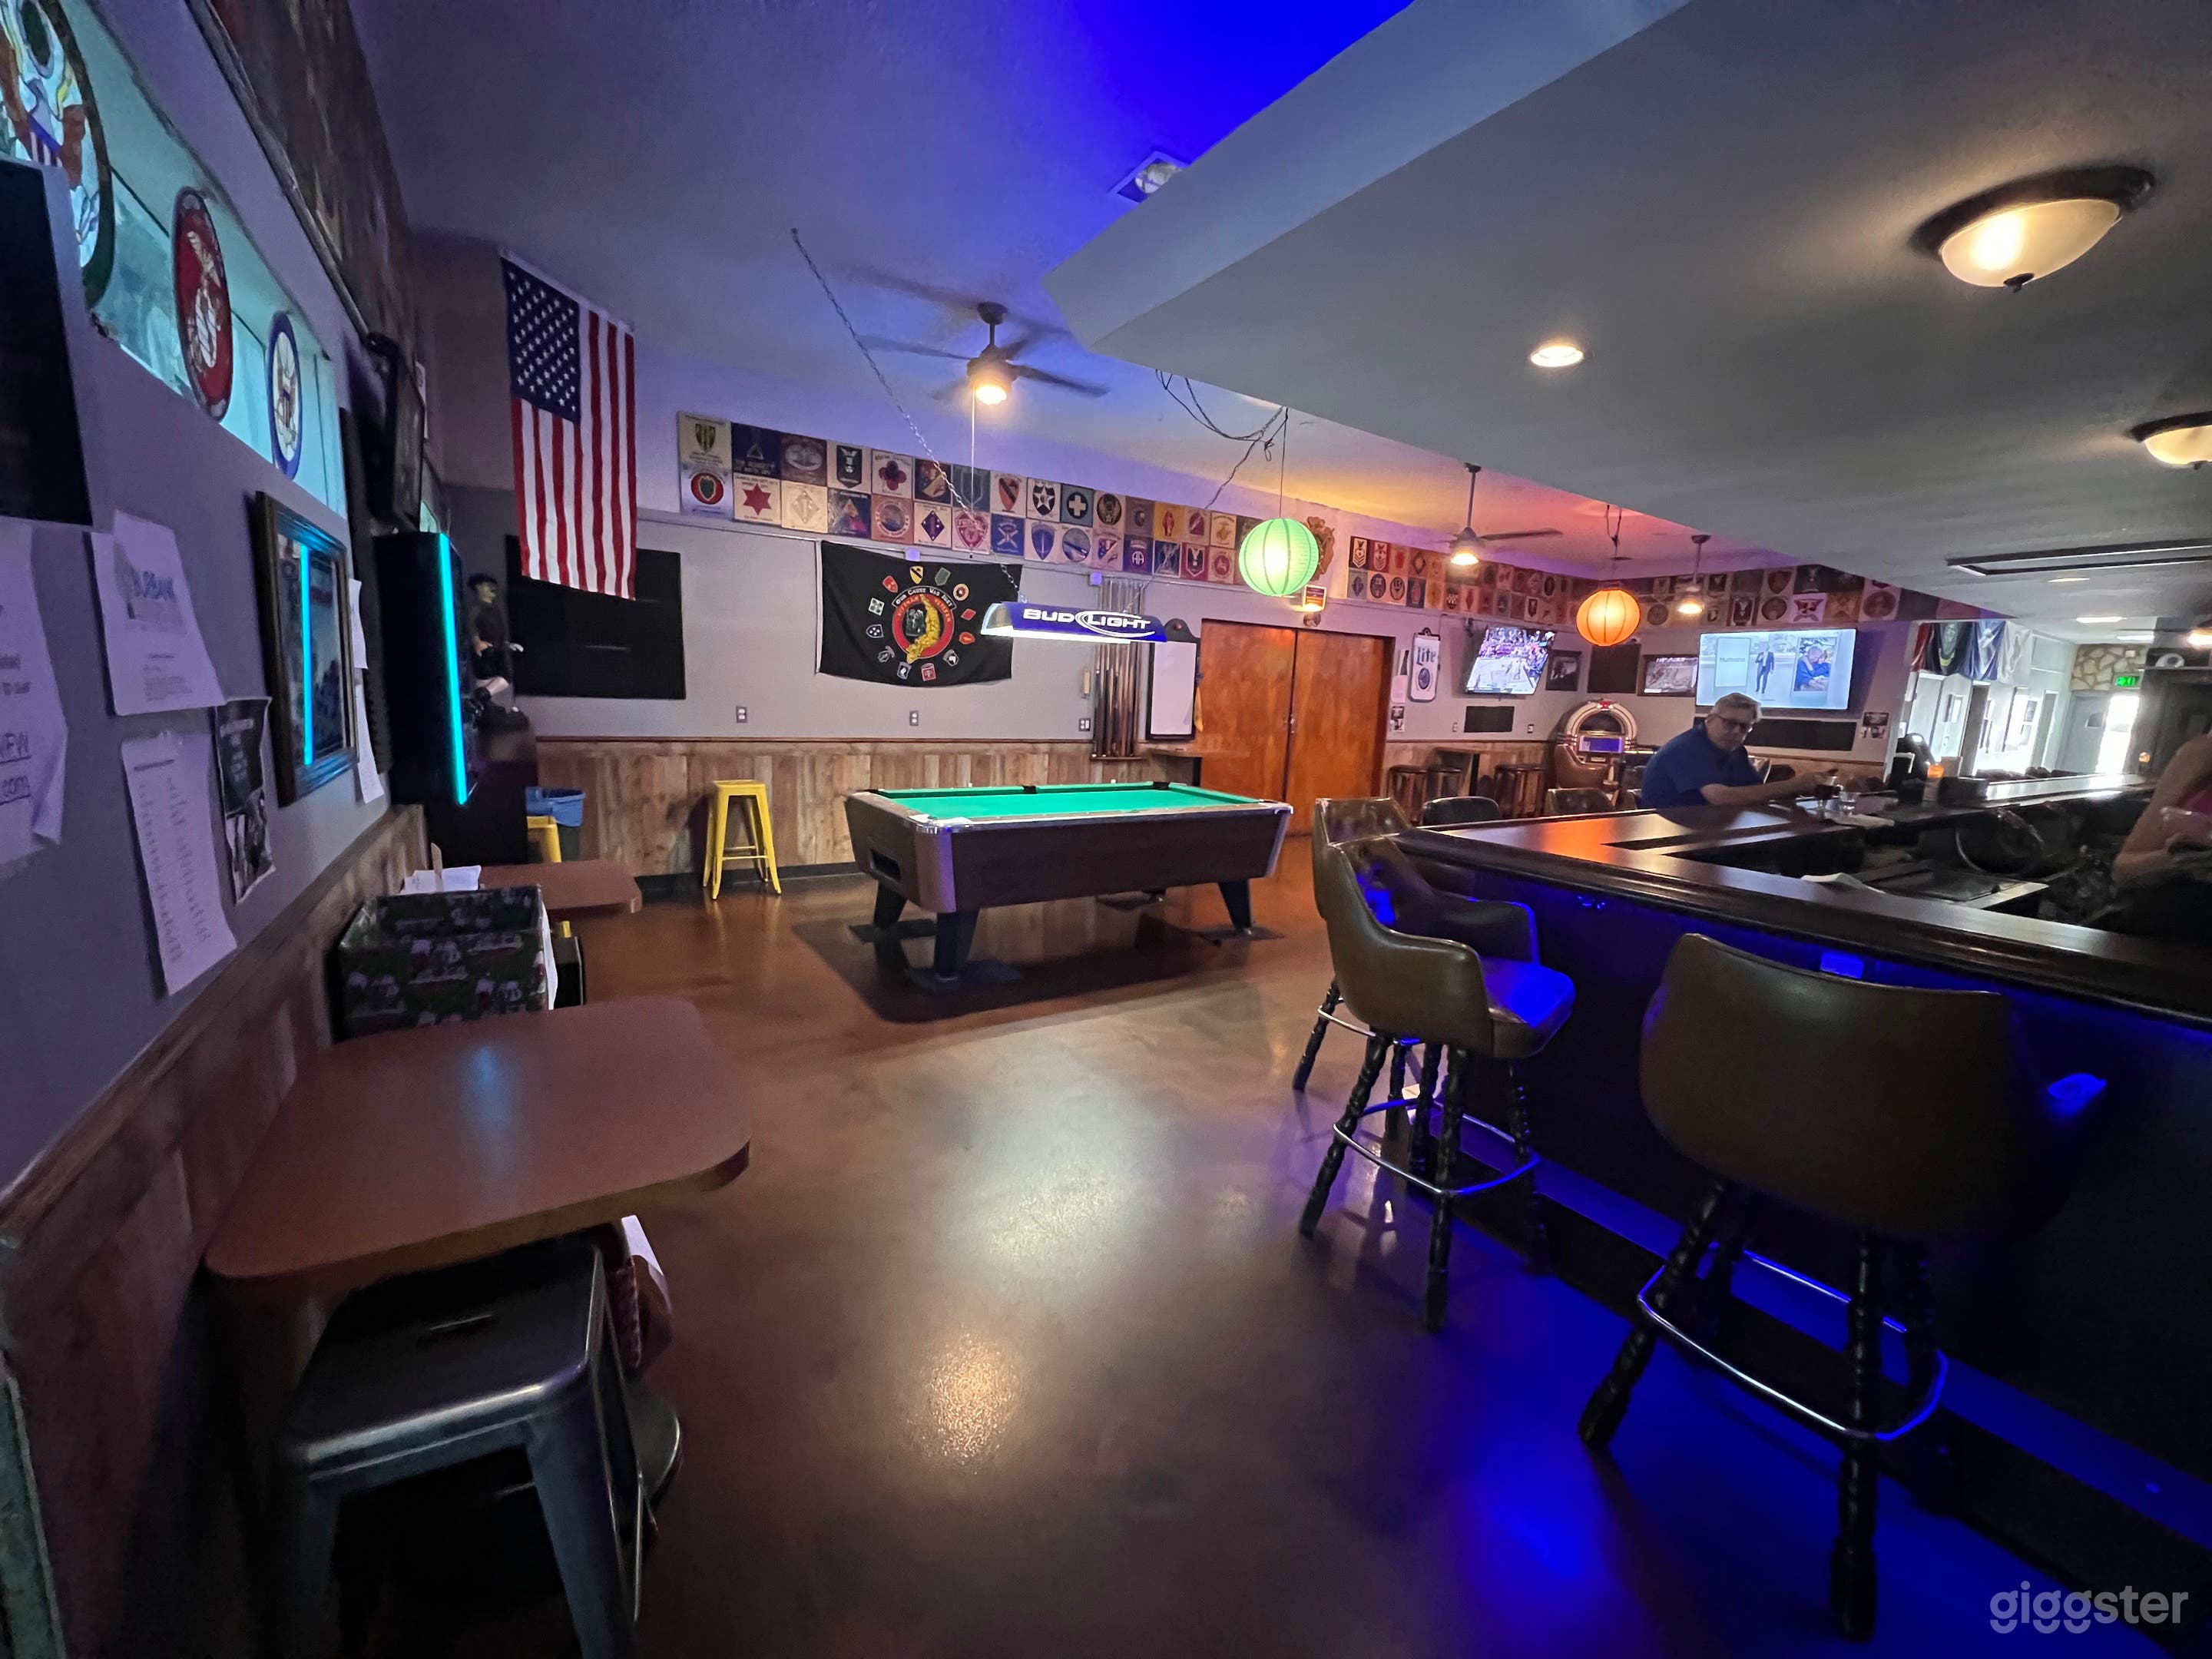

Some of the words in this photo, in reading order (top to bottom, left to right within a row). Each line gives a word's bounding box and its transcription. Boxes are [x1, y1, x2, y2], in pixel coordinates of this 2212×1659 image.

[1023, 608, 1075, 623] BUD
[1087, 614, 1151, 629] LIGHT
[1416, 646, 1436, 667] Lite
